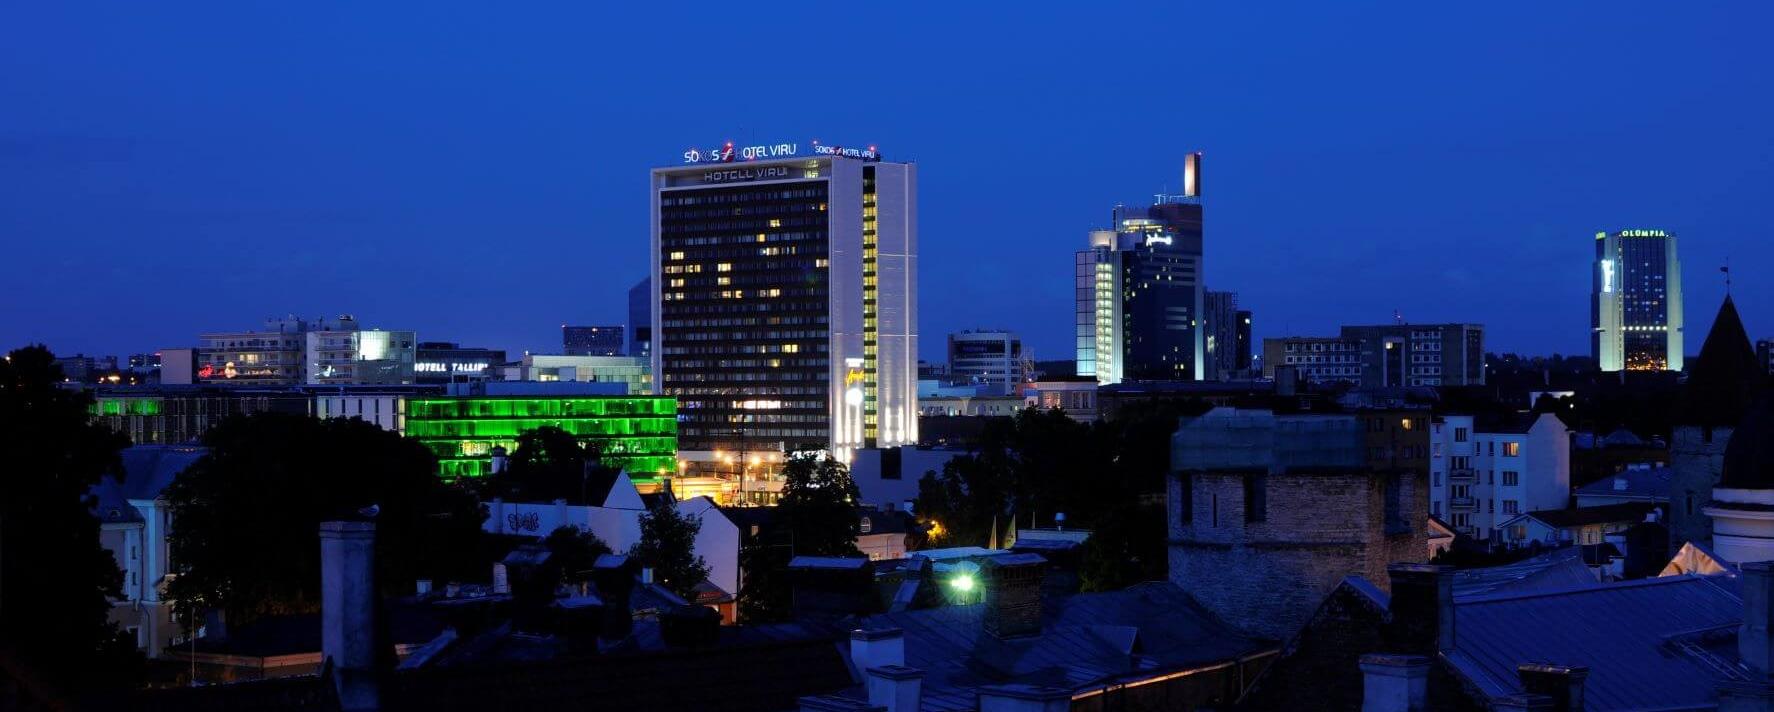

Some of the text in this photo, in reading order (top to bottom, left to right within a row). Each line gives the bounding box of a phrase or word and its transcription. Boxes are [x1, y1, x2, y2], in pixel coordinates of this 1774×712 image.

[684, 149, 720, 163] SOKOS
[770, 143, 797, 157] VIRU
[842, 148, 860, 157] HOTEL
